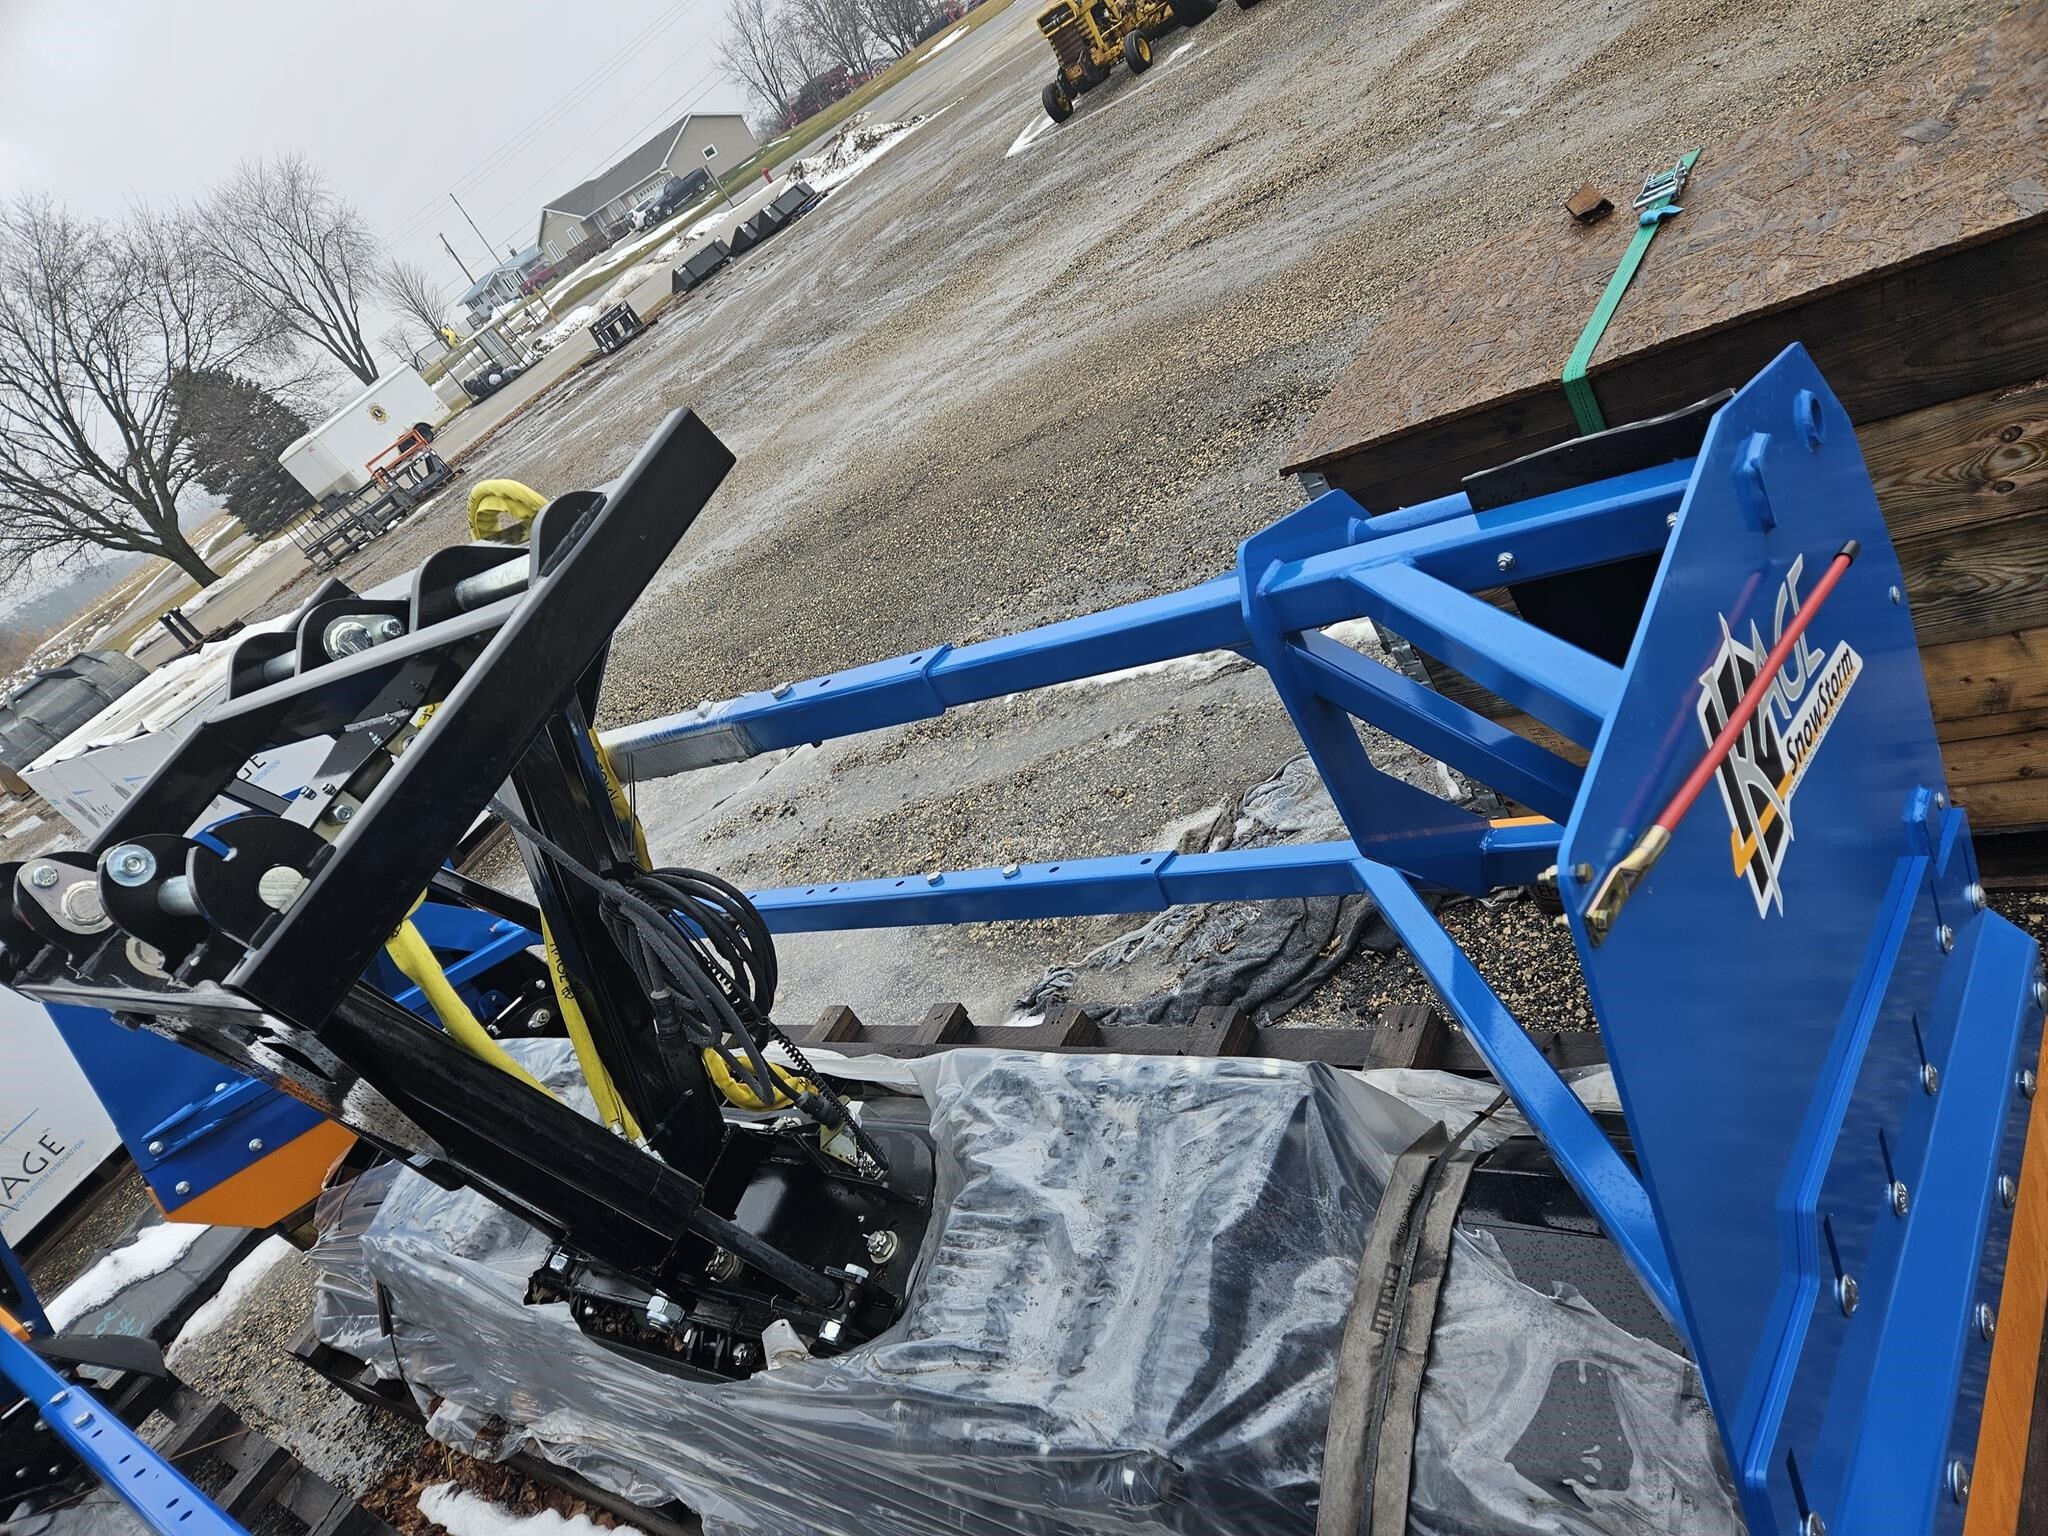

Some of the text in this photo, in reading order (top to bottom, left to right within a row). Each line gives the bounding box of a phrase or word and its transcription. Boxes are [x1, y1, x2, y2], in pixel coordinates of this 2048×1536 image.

[1787, 648, 1853, 777] SnowStorm
[0, 1134, 66, 1211] AGE
[47, 1138, 86, 1176] INNOVATION
